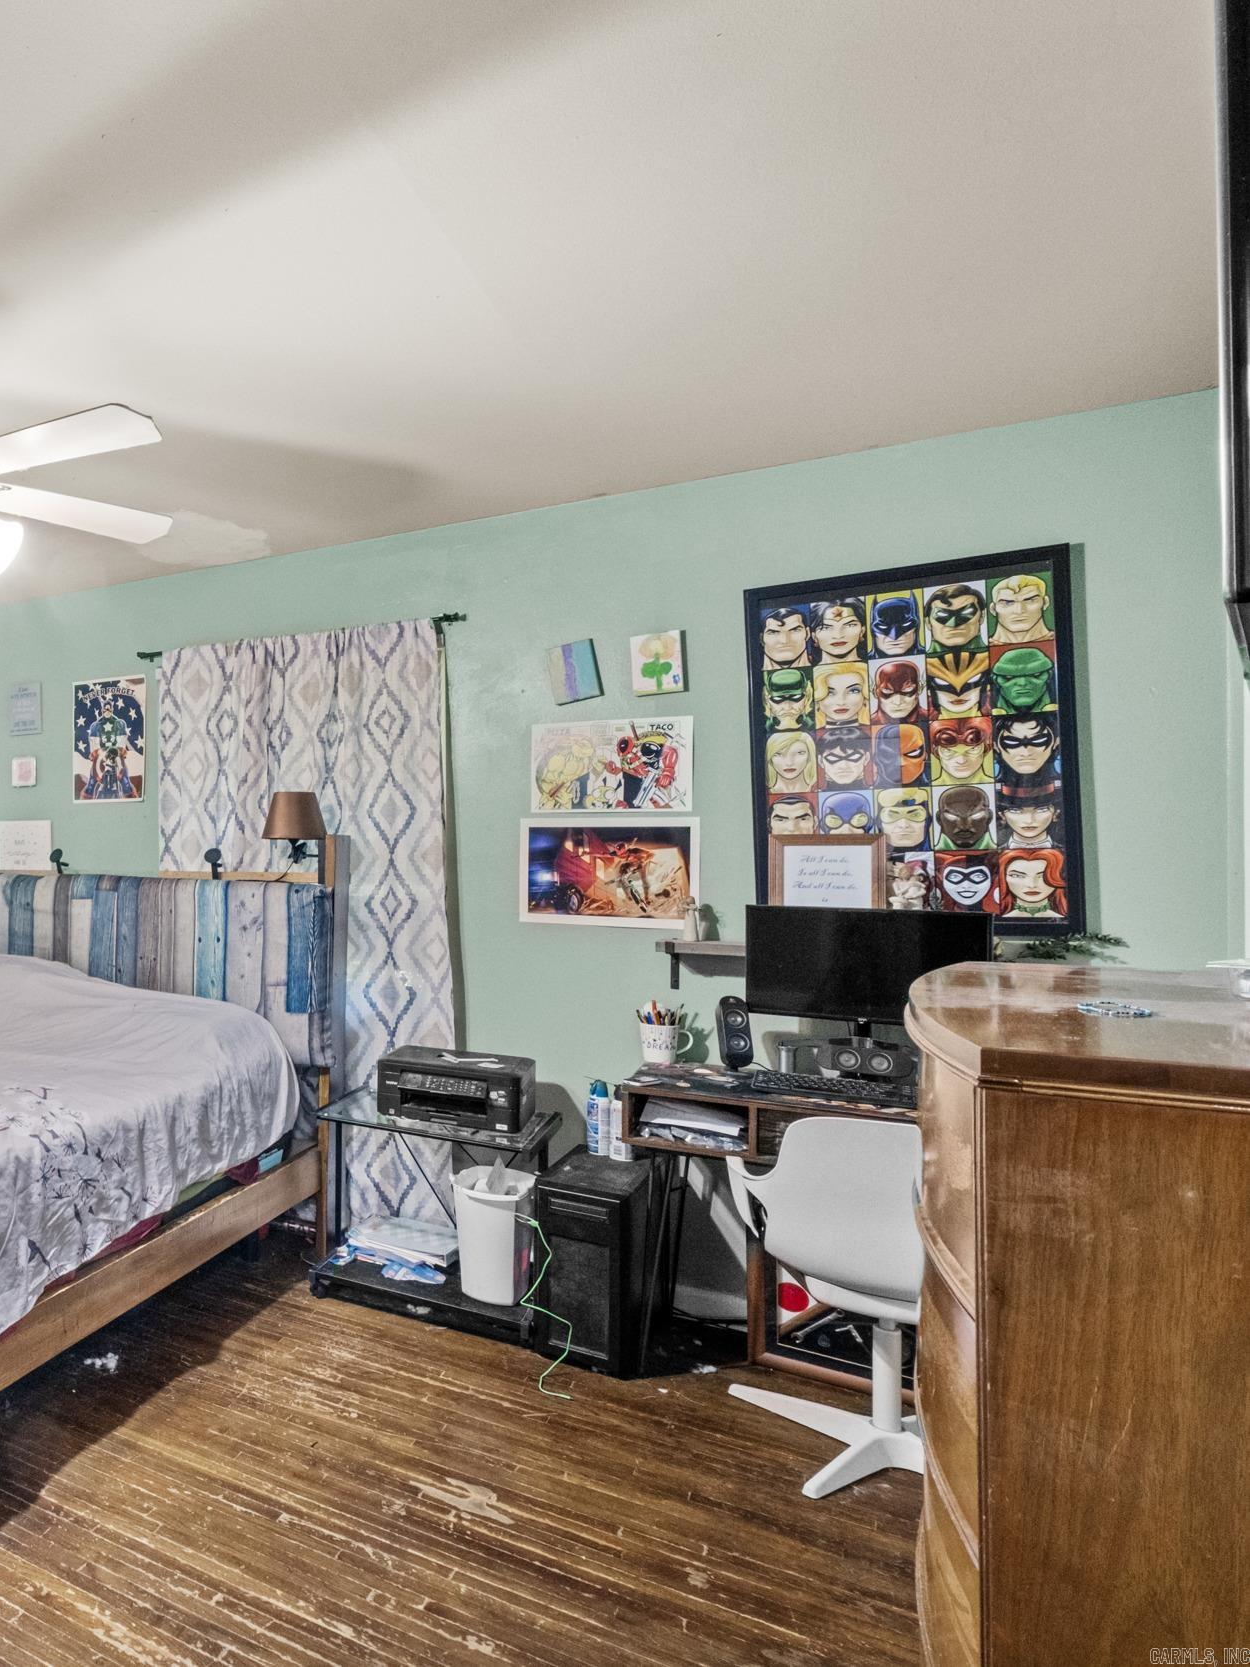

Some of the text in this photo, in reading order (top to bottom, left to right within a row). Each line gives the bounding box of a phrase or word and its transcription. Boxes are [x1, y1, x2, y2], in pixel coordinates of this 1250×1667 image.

[82, 687, 107, 702] NEVER
[649, 723, 674, 731] TACO
[800, 855, 816, 863] All
